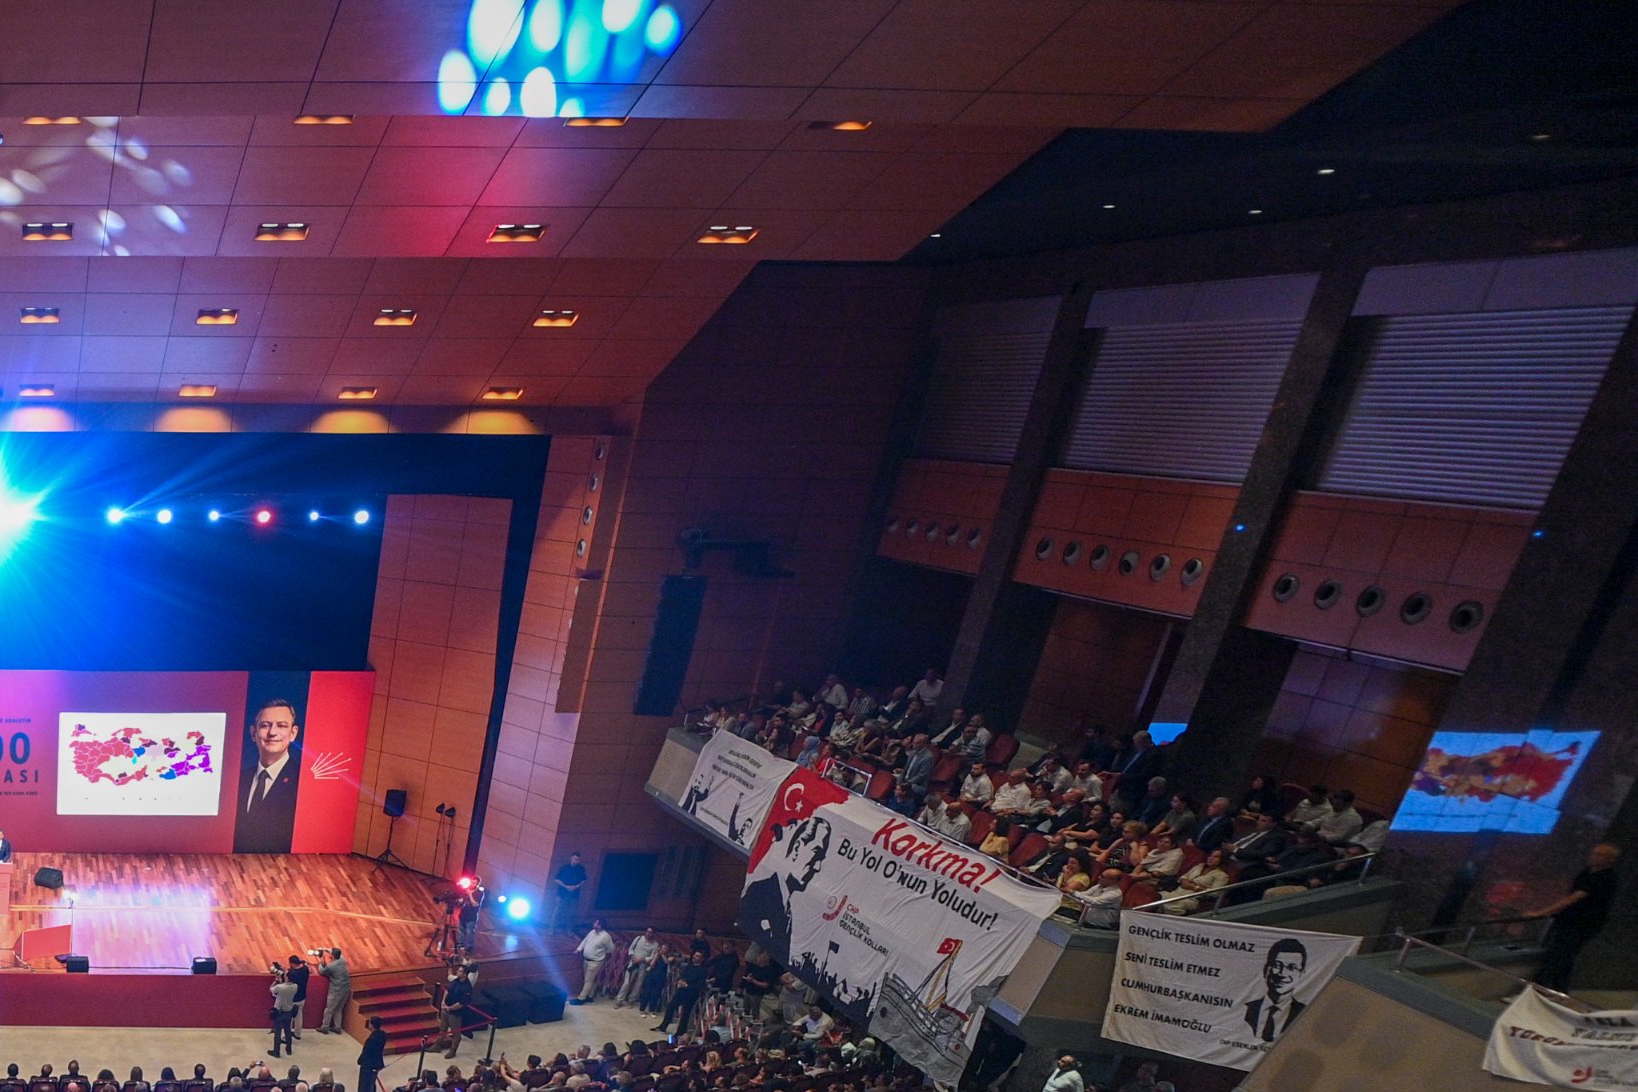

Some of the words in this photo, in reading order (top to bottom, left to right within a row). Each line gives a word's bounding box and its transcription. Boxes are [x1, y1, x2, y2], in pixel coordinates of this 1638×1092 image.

[871, 818, 1002, 893] Korkma!
[837, 838, 859, 861] Bu
[861, 847, 883, 873] Yol
[931, 879, 998, 931] Yoludur!
[1129, 925, 1172, 942] GENÇLİK
[1174, 933, 1210, 948] TESLİM
[1213, 938, 1255, 952] OLMAZ
[1125, 952, 1147, 964] SENİ
[1149, 957, 1184, 971] TESLİM
[1186, 964, 1221, 978] ETMEZ
[1121, 978, 1234, 1008] CUMHURBAŞKANISIN
[1114, 1004, 1149, 1020] EKREM
[1151, 1009, 1212, 1033] İMAMOĞLU
